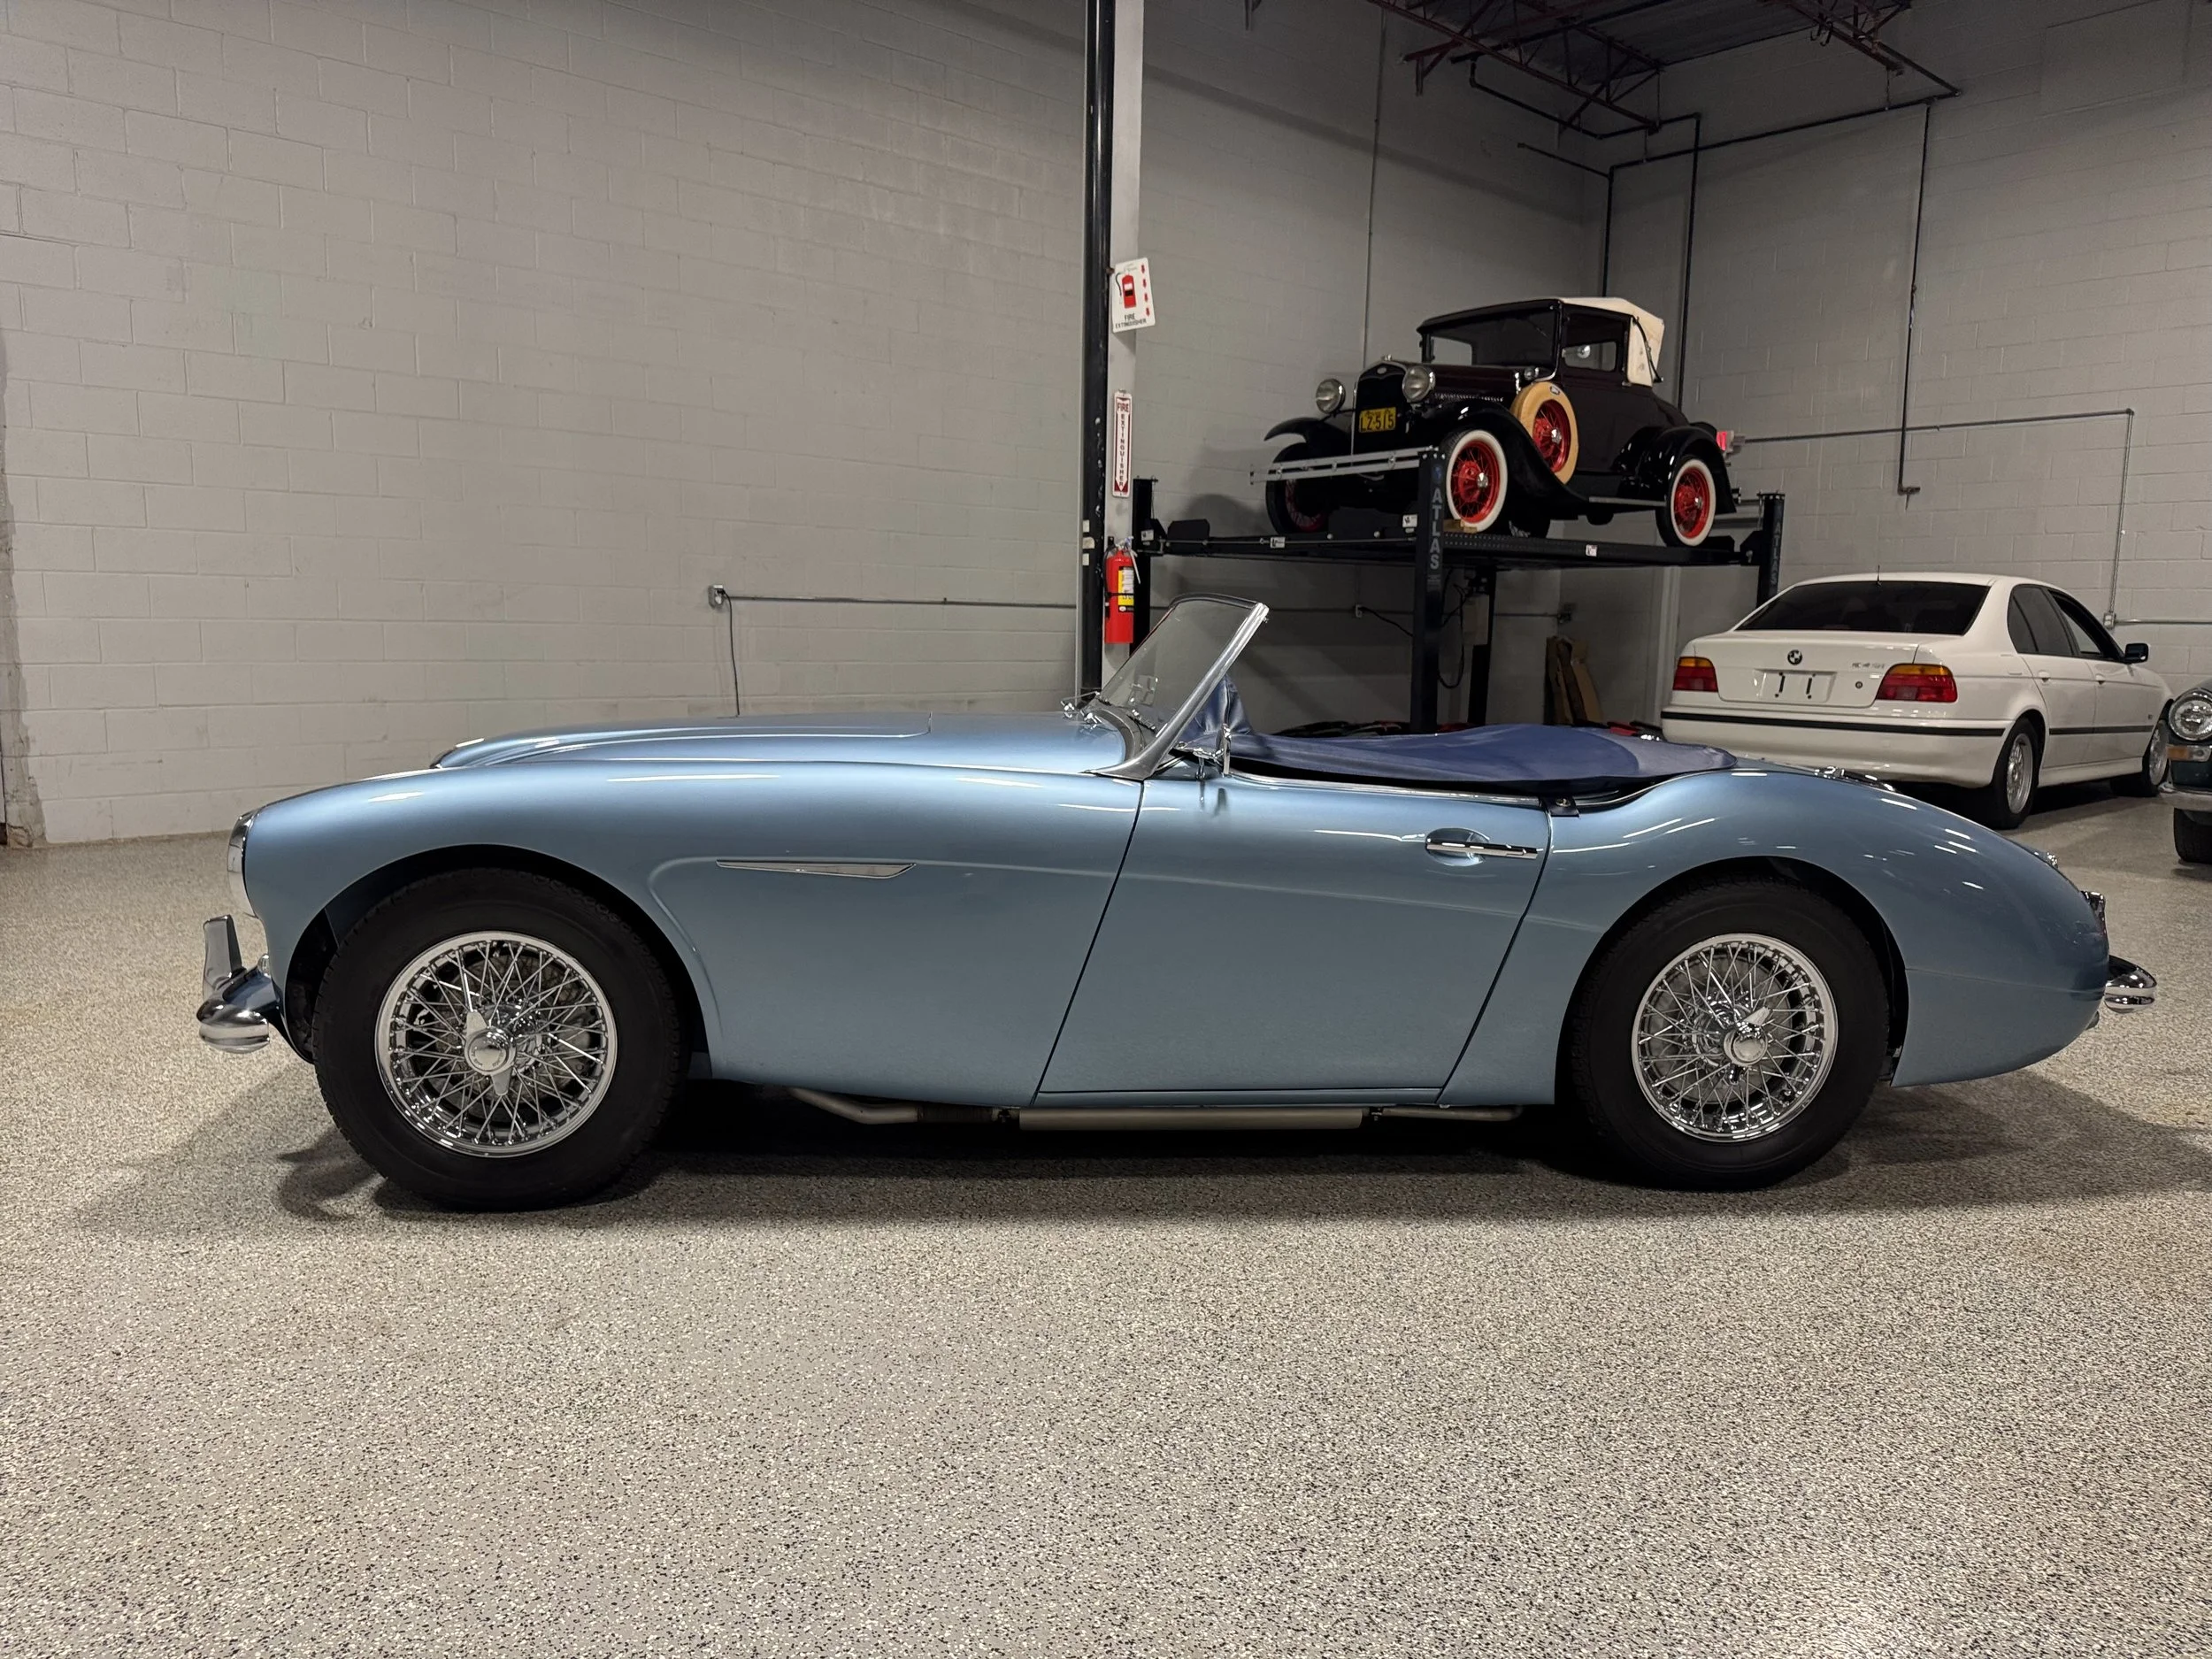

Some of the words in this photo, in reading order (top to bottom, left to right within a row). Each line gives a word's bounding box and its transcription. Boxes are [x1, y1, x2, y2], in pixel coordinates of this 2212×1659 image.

[1124, 312, 1135, 321] FIRE
[1116, 318, 1147, 328] EXTINGUISHER
[1118, 403, 1129, 412] FIRE
[1430, 488, 1442, 570] ATLAS
